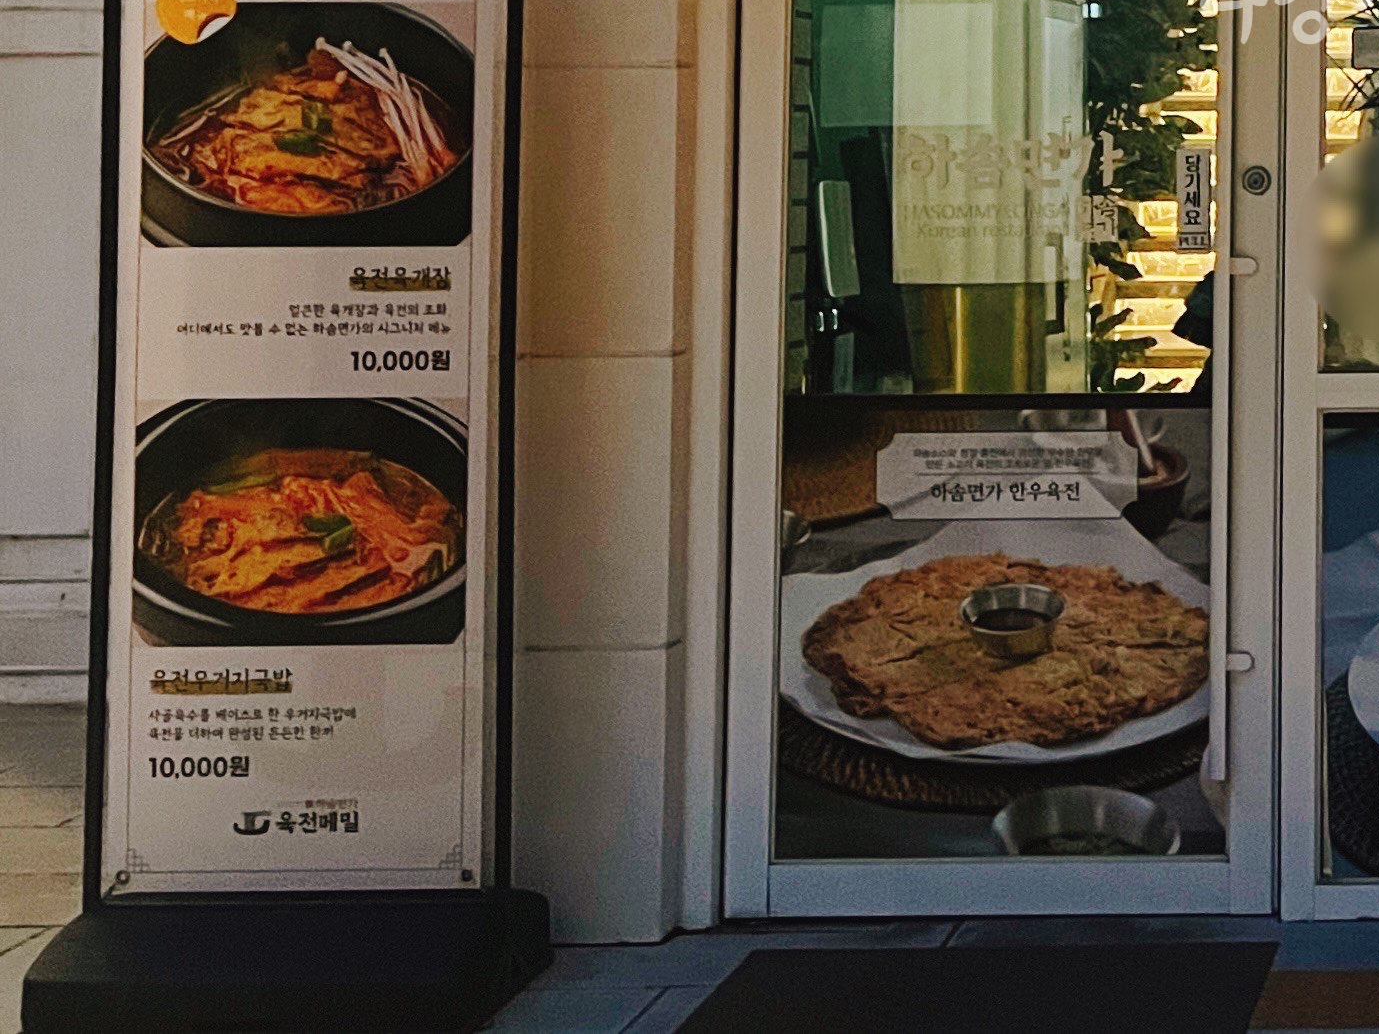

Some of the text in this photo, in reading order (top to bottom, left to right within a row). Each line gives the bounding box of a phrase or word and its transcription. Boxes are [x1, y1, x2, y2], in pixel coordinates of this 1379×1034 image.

[1184, 154, 1201, 225] 당기세요
[268, 323, 281, 335] 수
[350, 349, 451, 372] 10,000원
[930, 481, 1081, 503] 하솜면가 한우육전
[149, 756, 250, 779] 10,000원
[275, 810, 359, 834] 육전메밀
